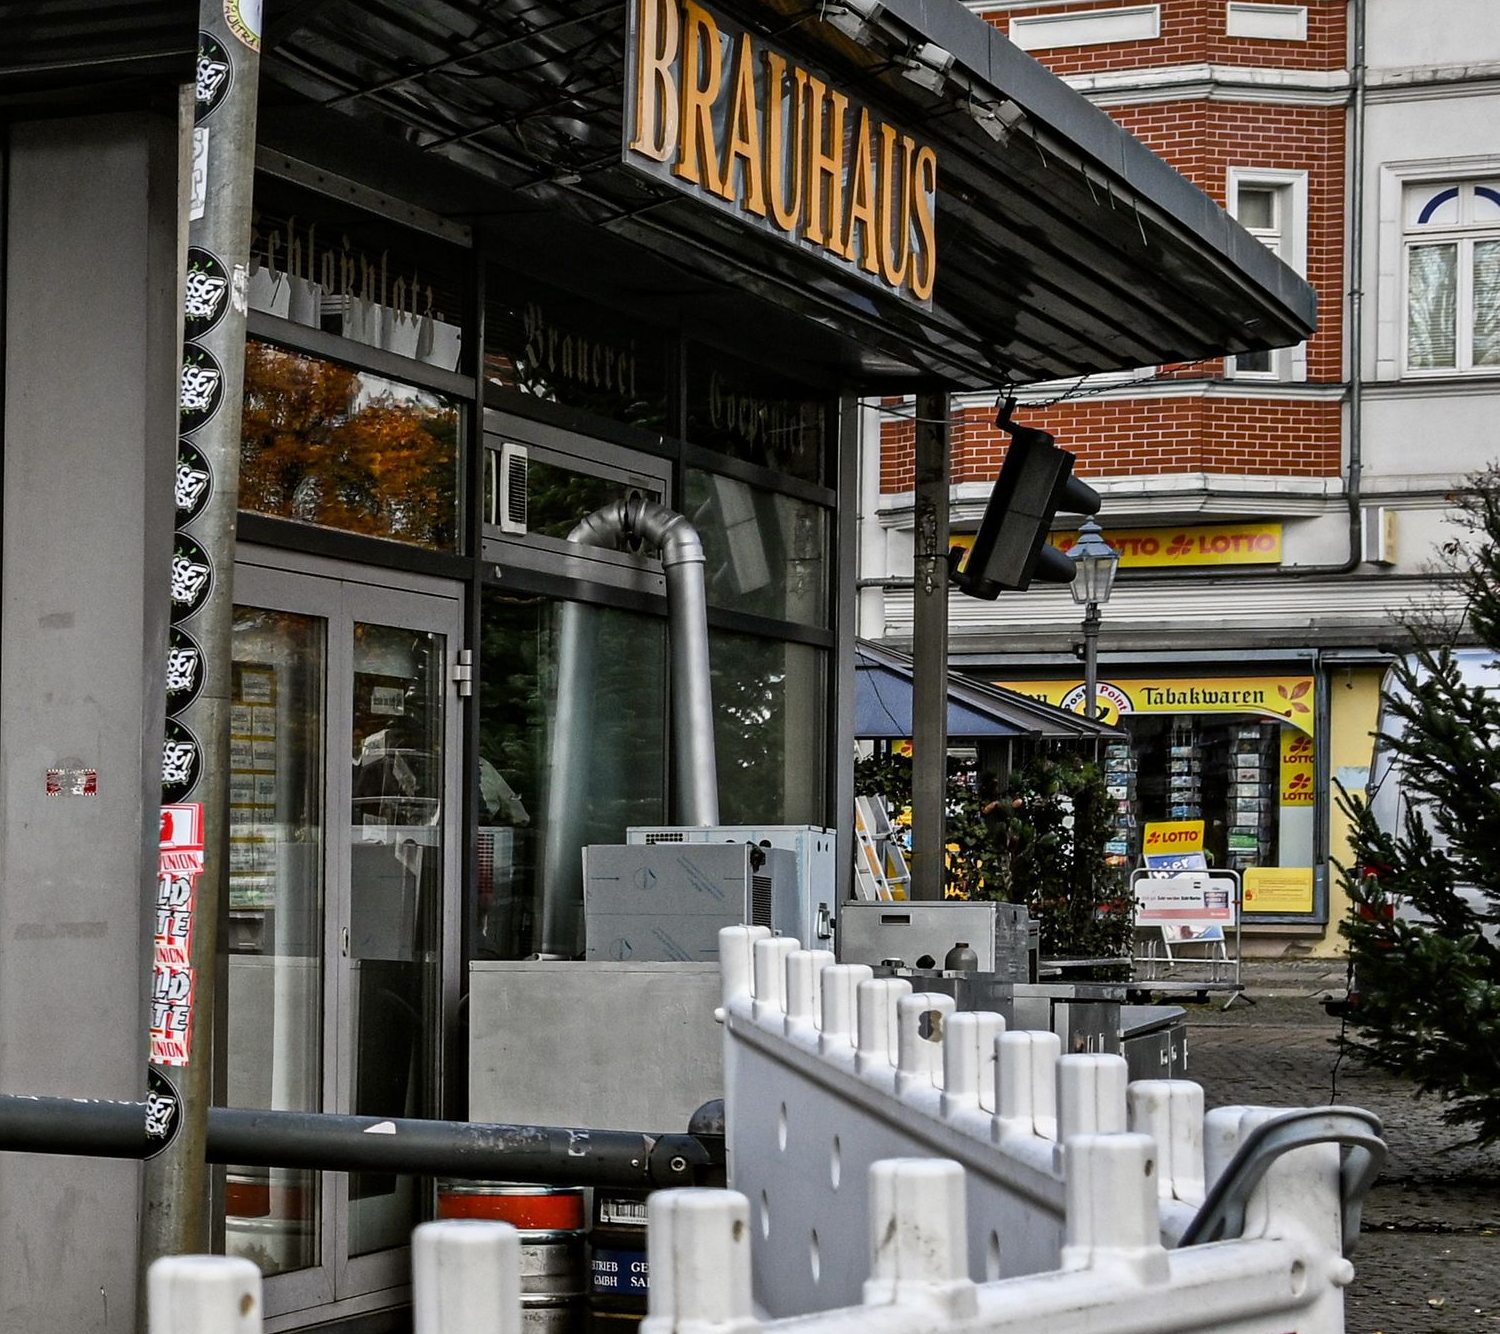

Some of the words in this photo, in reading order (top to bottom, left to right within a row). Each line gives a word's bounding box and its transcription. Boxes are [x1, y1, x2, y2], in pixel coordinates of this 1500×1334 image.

[1199, 533, 1277, 554] LOTTO
[1100, 685, 1128, 711] Point
[1139, 687, 1265, 706] Tabakwaren
[1161, 830, 1199, 844] LOTTO
